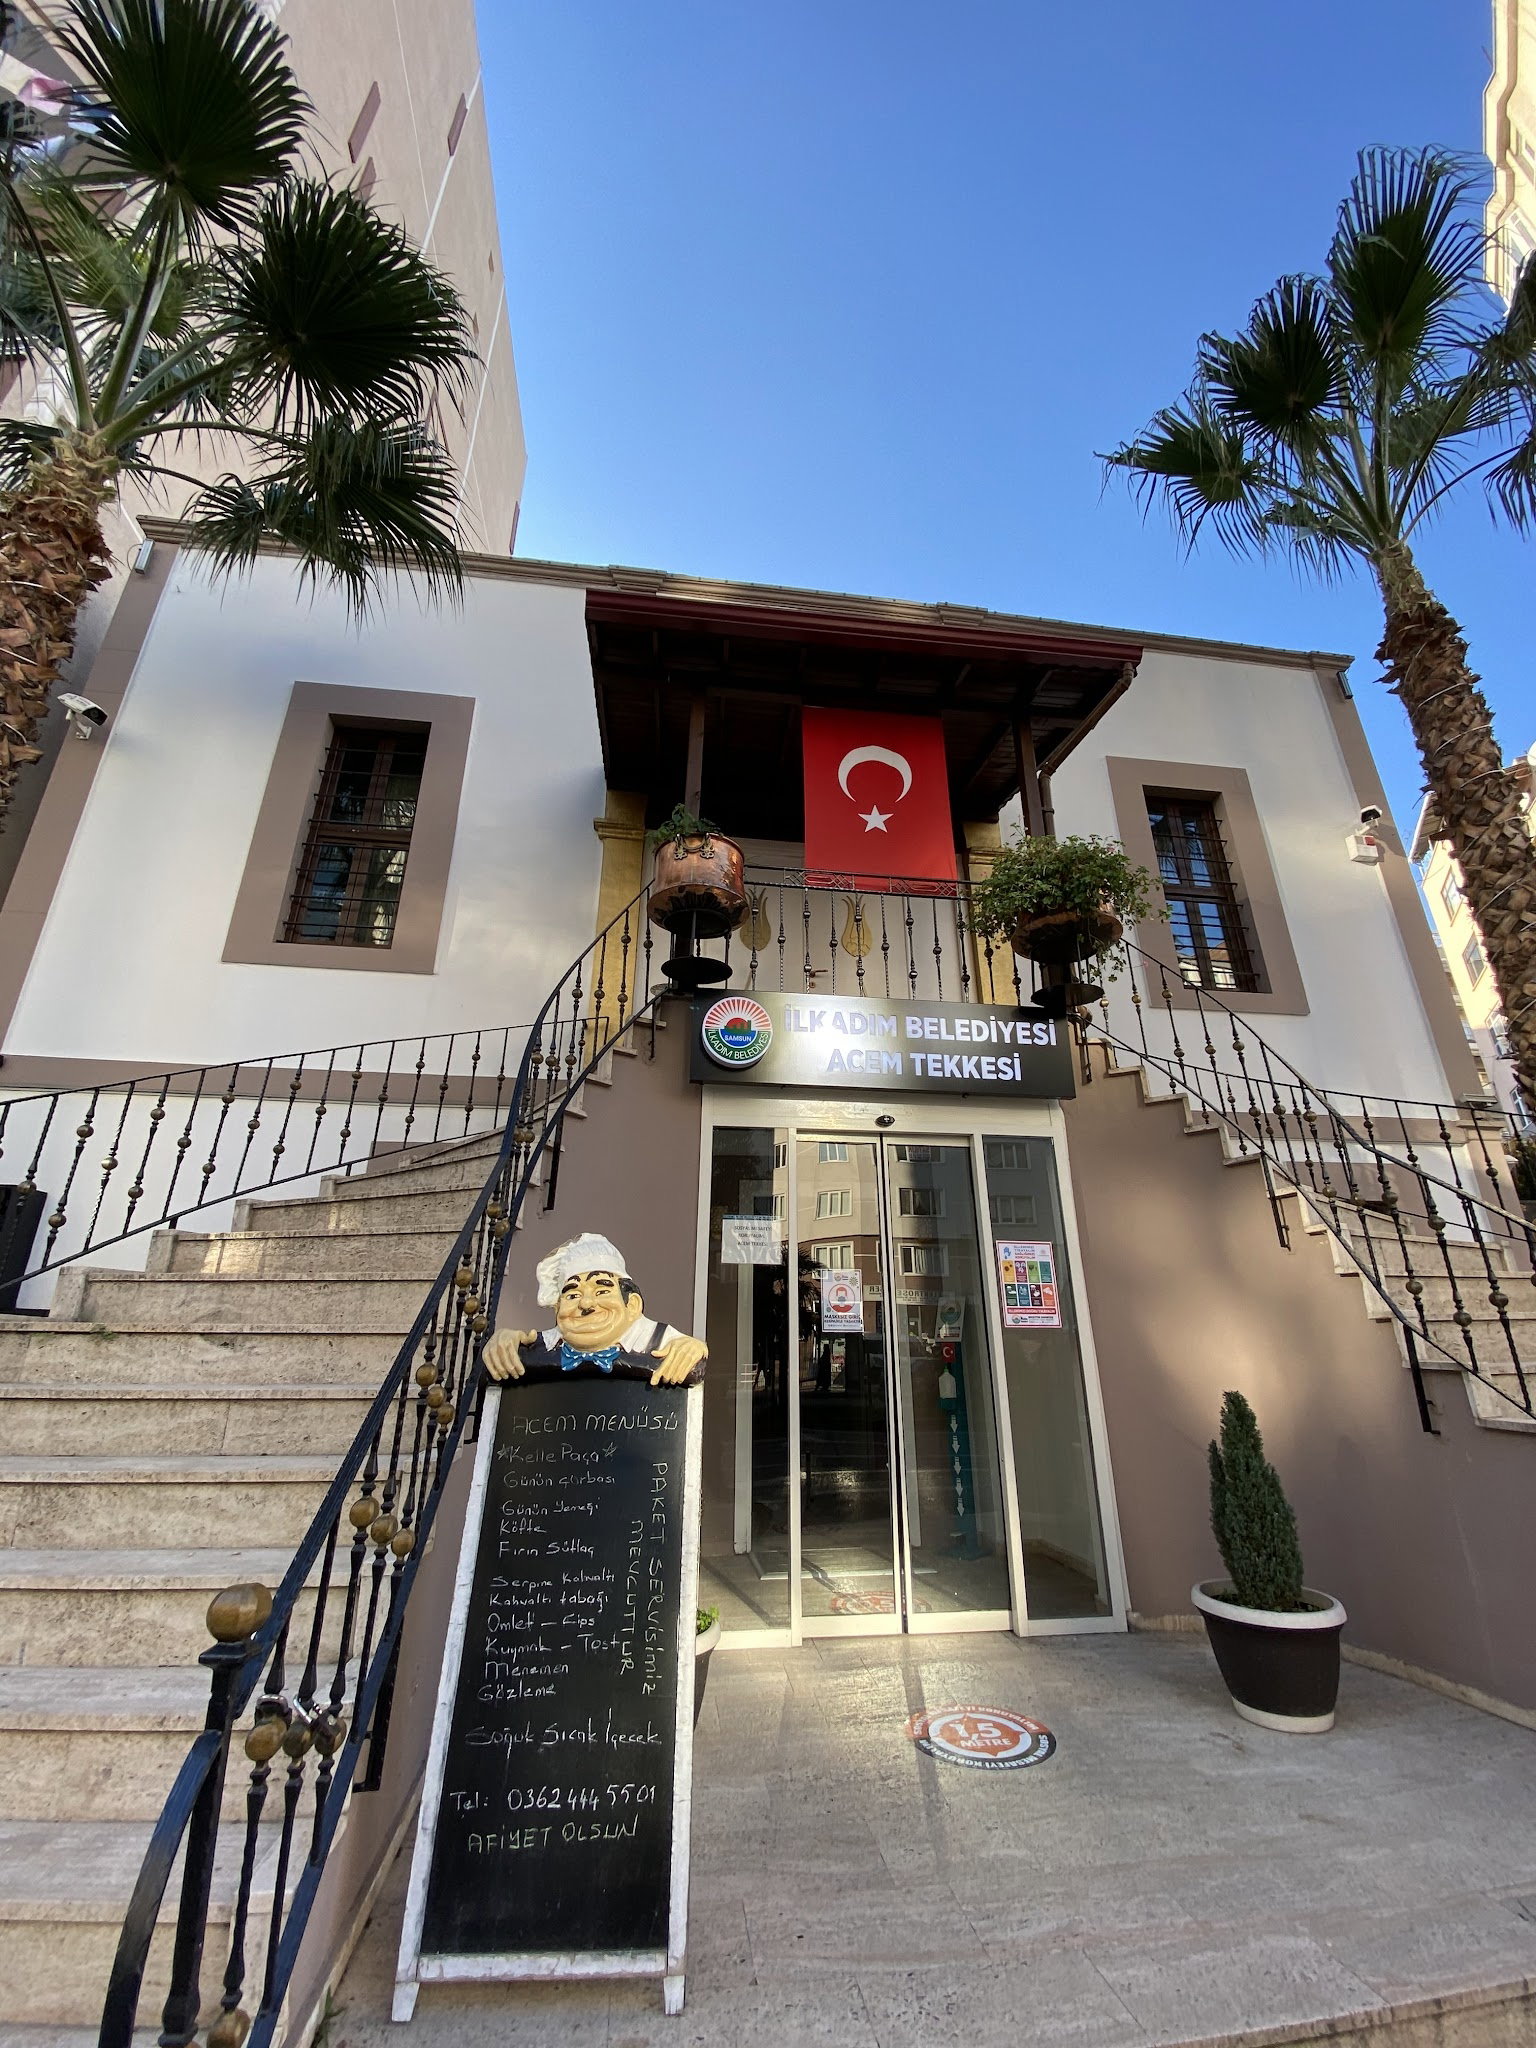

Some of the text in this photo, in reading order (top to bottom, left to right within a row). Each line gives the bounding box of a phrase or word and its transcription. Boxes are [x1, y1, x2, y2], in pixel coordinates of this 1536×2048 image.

[784, 1003, 1057, 1046] İLKADIM BELEDİYESİ
[724, 1034, 752, 1042] SAMSUN
[734, 1031, 769, 1059] BELEDİYESİ
[826, 1048, 1022, 1081] ACEM TEKKESİ
[512, 1406, 679, 1436] ACEM MENÜSÜ
[509, 1442, 600, 1466] Kelle Paça
[503, 1470, 553, 1489] Günün
[502, 1500, 548, 1516] Günün
[650, 1462, 668, 1544] PAKET
[500, 1517, 547, 1535] Köfte
[499, 1538, 595, 1559] Fırın Sütlaç
[489, 1589, 609, 1614] Kahvaltı tabağı
[487, 1611, 535, 1633] Omlet
[485, 1635, 552, 1663] Kuymak
[485, 1661, 569, 1680] Menemen
[478, 1679, 557, 1701] Gözleme
[465, 1721, 535, 1759] Soğuk
[605, 1707, 662, 1750] İçecek
[960, 1737, 1012, 1748] METRE
[450, 1784, 657, 1812] Tel: 0362 444 5501
[468, 1814, 639, 1855] AFİYET OLSUN
